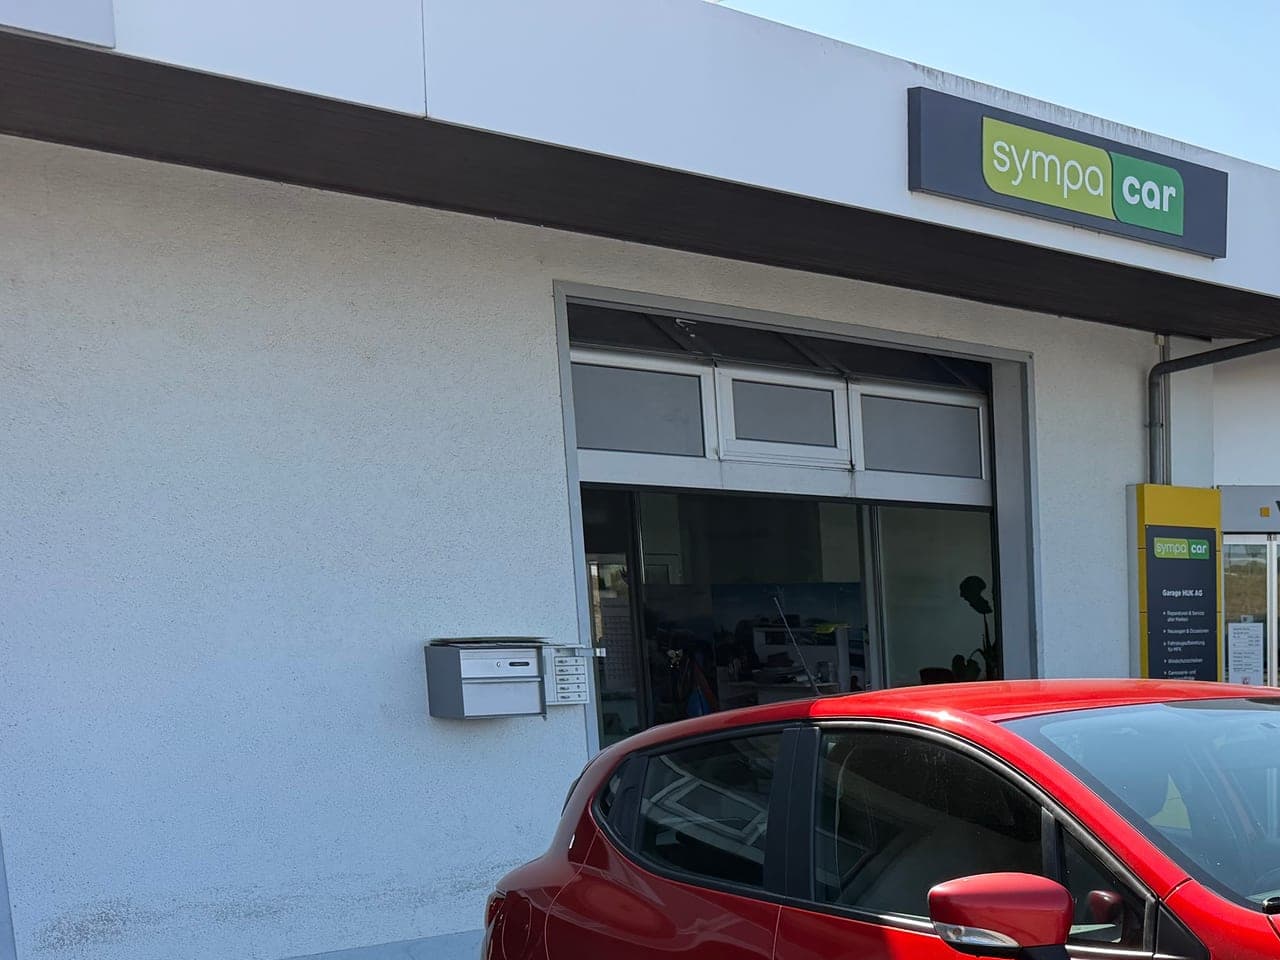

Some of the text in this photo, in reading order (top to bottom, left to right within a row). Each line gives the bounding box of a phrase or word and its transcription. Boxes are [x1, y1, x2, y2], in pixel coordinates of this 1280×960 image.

[992, 140, 1177, 213] sympa car
[1156, 543, 1208, 555] sympa car
[1162, 589, 1182, 598] Garage
